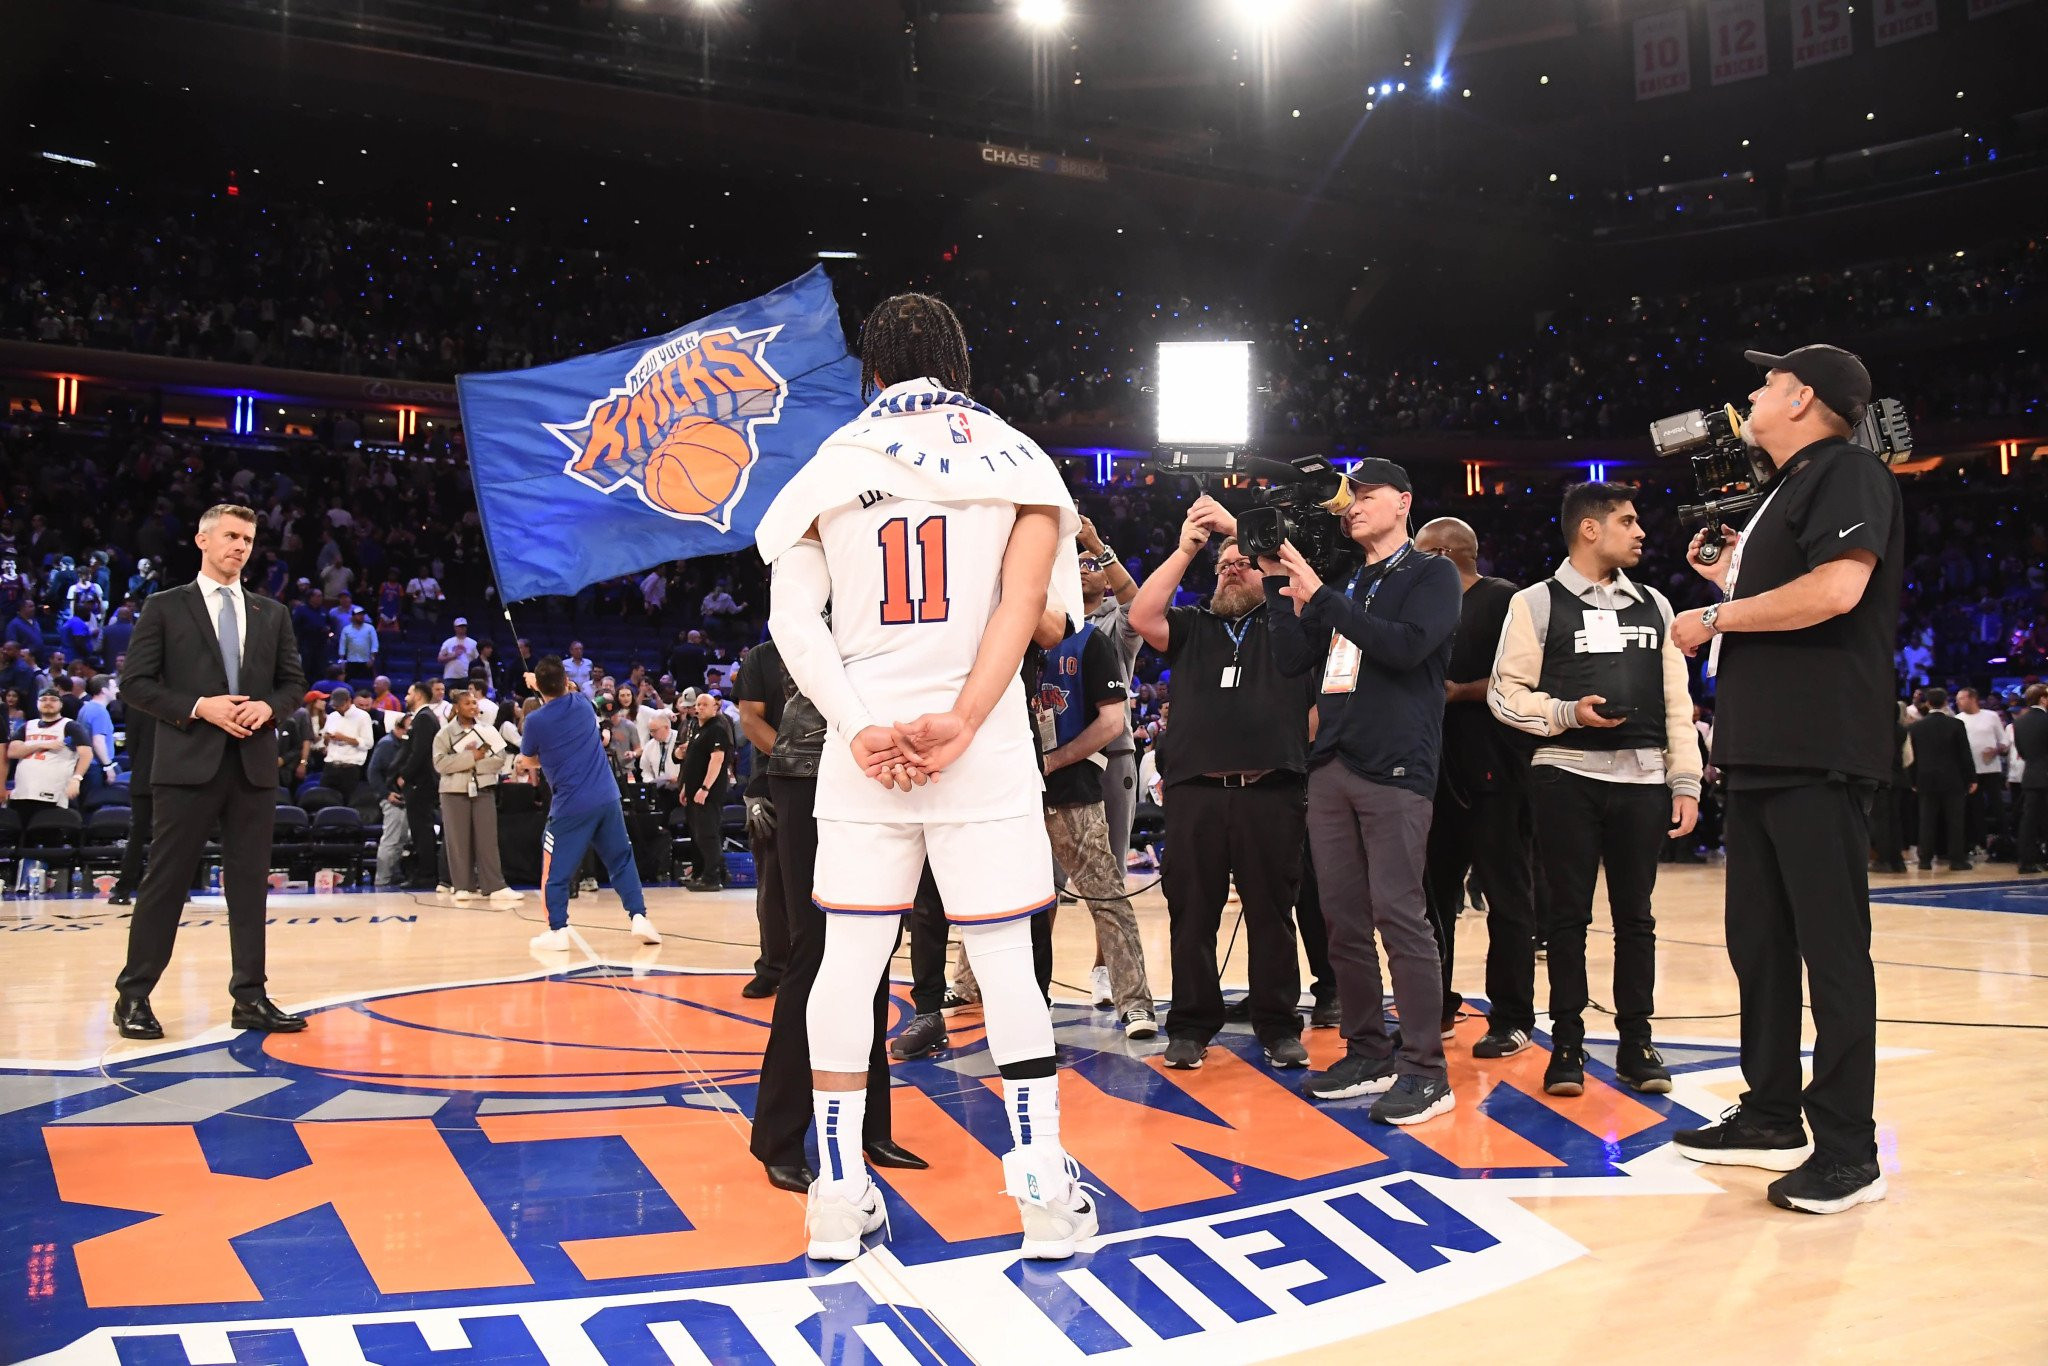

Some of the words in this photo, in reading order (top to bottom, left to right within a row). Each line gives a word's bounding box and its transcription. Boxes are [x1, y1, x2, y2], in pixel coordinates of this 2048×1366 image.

[1801, 0, 1840, 38] 15
[1644, 37, 1680, 72] 10
[1719, 19, 1757, 57] 12
[982, 148, 1041, 168] CHASE
[1060, 160, 1108, 181] BRIDGE
[630, 354, 659, 393] NEW
[657, 335, 697, 364] YORK
[572, 332, 779, 471] KNICKS
[1662, 426, 1687, 437] AMIRA
[886, 441, 950, 474] NEW
[981, 443, 1034, 473] ALL
[878, 515, 950, 626] 11
[1059, 655, 1078, 676] 10
[1003, 1182, 1502, 1358] NEW
